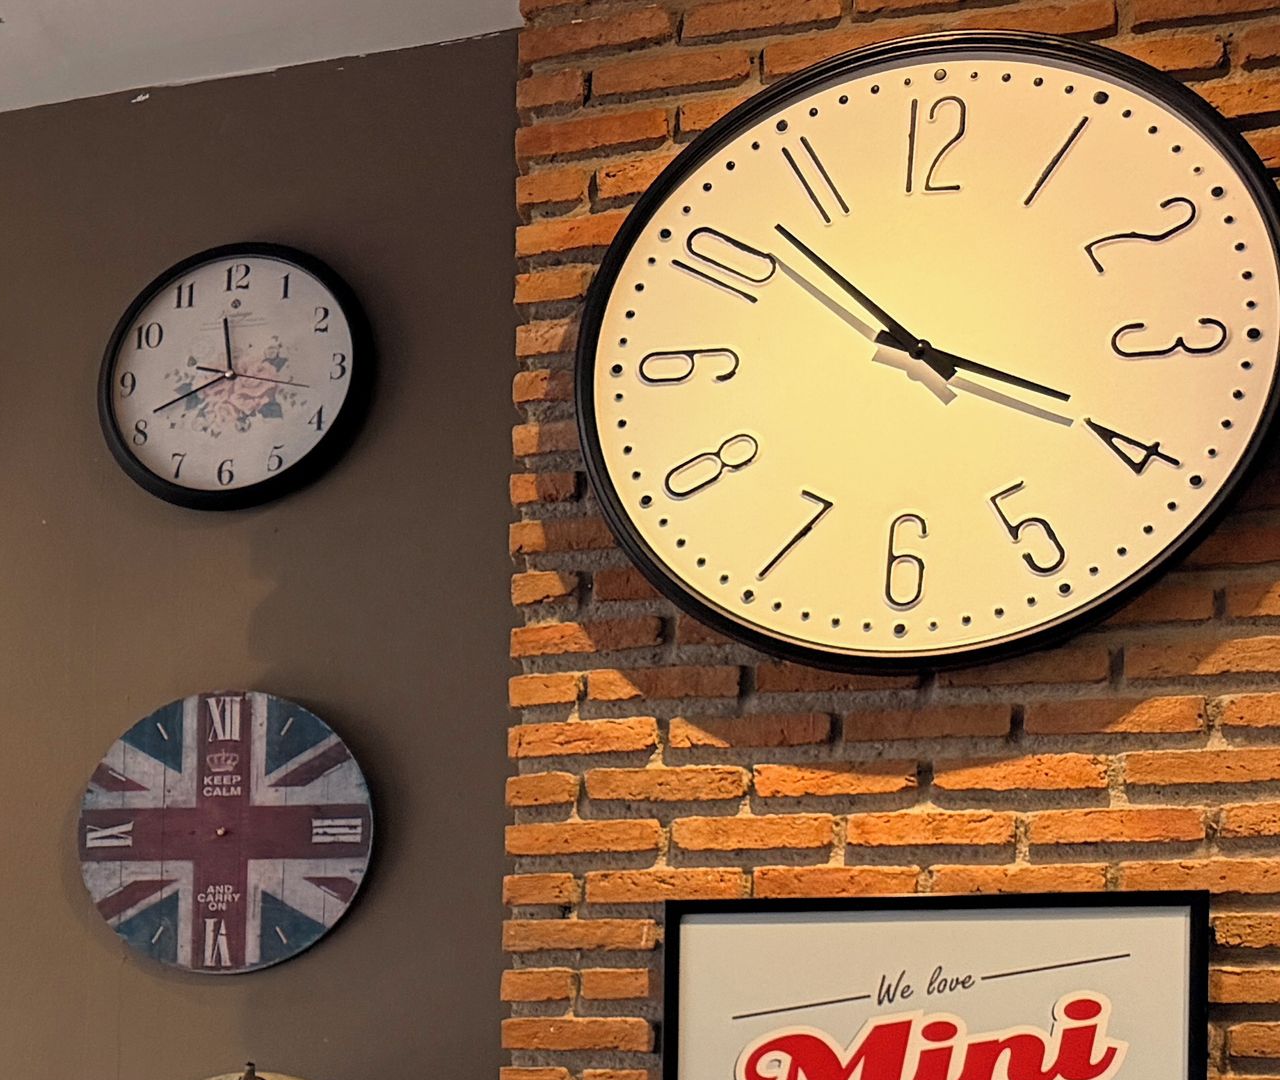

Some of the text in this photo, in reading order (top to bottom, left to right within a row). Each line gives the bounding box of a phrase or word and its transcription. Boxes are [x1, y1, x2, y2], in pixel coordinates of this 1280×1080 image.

[904, 94, 966, 193] 12
[1024, 114, 1089, 206] 1
[782, 136, 850, 224] 11
[1083, 196, 1197, 274] 2
[224, 264, 251, 292] 12
[672, 226, 776, 303] 10
[172, 282, 196, 310] 11
[280, 272, 290, 300] 1
[314, 306, 329, 334] 2
[134, 322, 164, 350] 10
[1110, 316, 1228, 358] 3
[329, 352, 346, 381] 3
[638, 348, 740, 383] 9
[120, 371, 136, 399] 9
[308, 404, 325, 432] 4
[132, 419, 148, 446] 8
[1084, 416, 1180, 474] 4
[171, 453, 186, 479] 7
[216, 458, 234, 486] 6
[266, 444, 284, 472] 5
[664, 434, 760, 498] 8
[758, 488, 834, 580] 7
[989, 480, 1065, 574] 5
[885, 512, 928, 608] 6
[206, 696, 243, 742] XII
[203, 786, 242, 797] CALM
[204, 775, 242, 786] KEEP
[86, 820, 134, 848] IX
[311, 818, 362, 844] III
[198, 893, 240, 902] CARRY
[206, 885, 233, 894] AND
[208, 902, 227, 912] ON
[204, 918, 232, 967] VI
[878, 966, 975, 1006] We love
